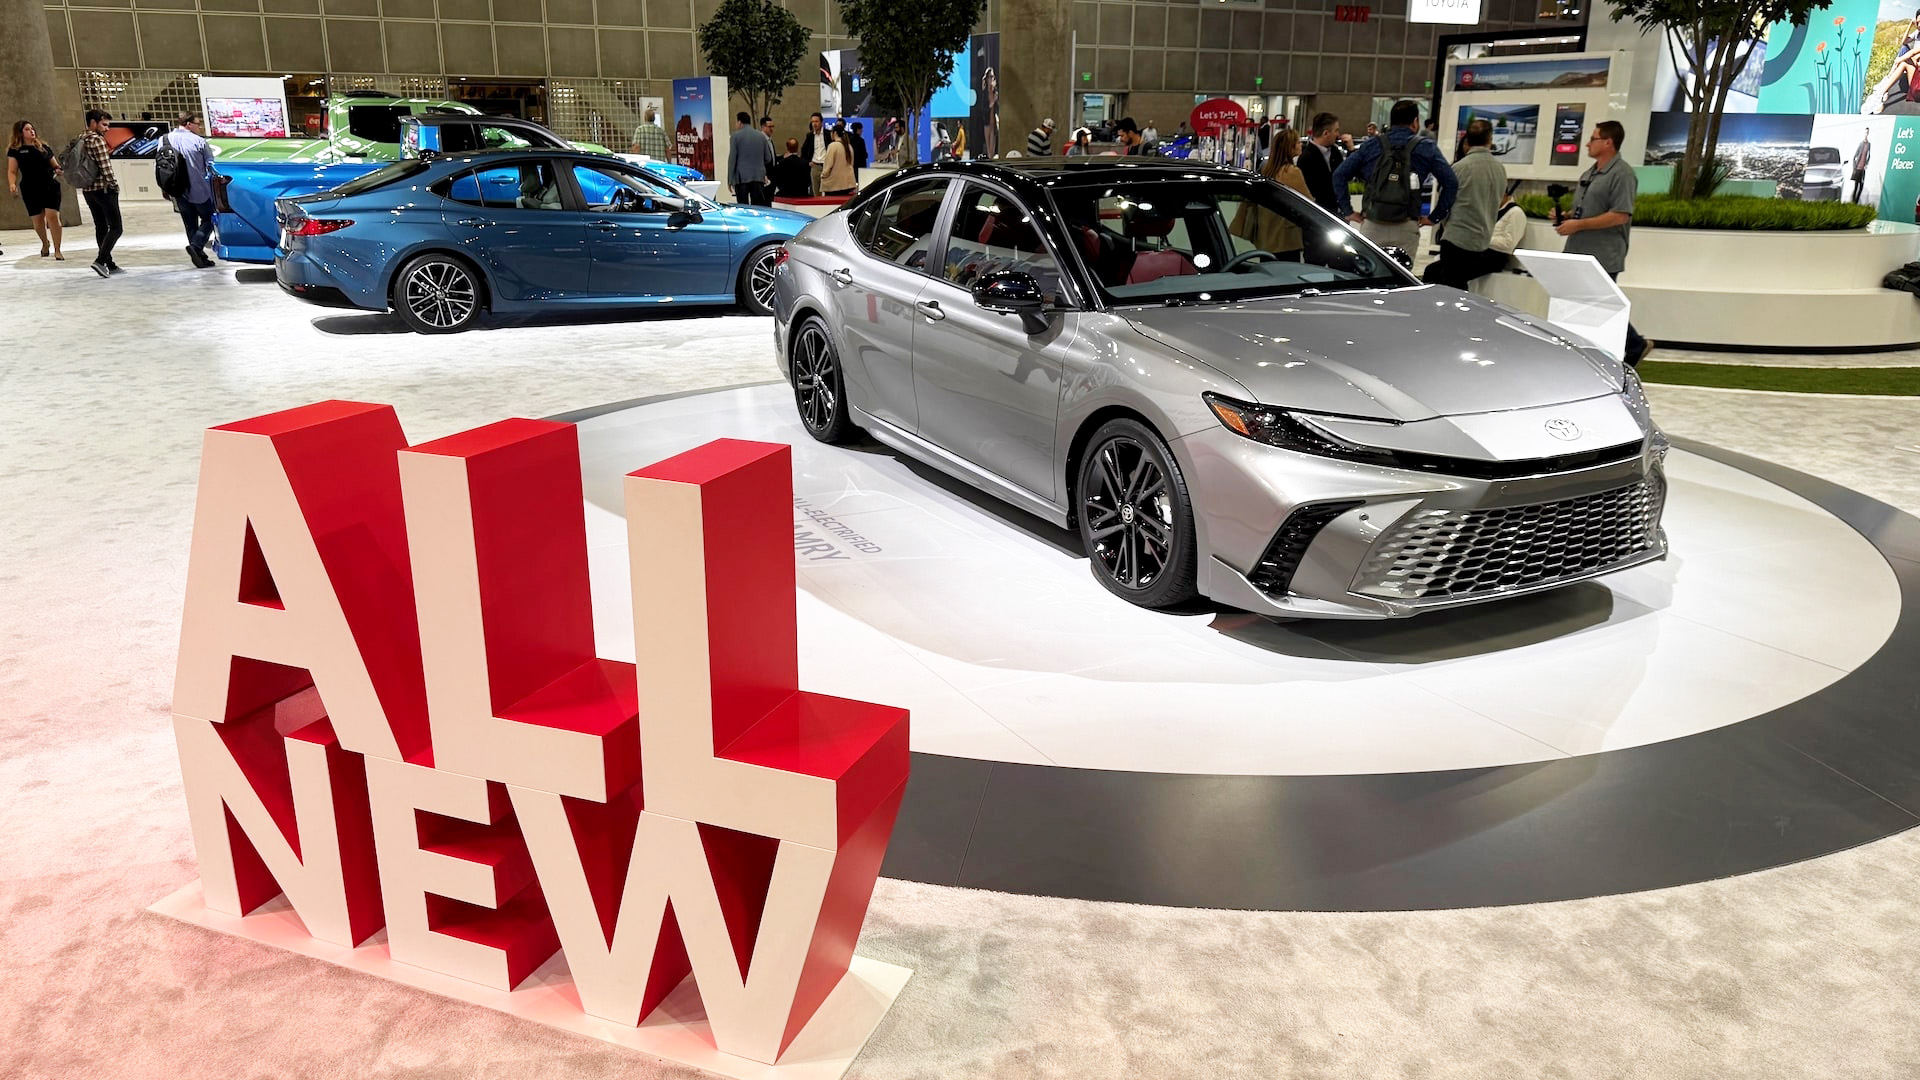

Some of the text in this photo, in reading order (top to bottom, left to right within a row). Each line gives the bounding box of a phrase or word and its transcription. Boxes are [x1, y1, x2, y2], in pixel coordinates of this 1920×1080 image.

[1199, 111, 1217, 120] Let's
[1897, 127, 1914, 138] Let's
[1894, 142, 1906, 155] Go
[1891, 158, 1914, 169] Places
[171, 418, 838, 852] ALL
[171, 712, 838, 1066] NEW
